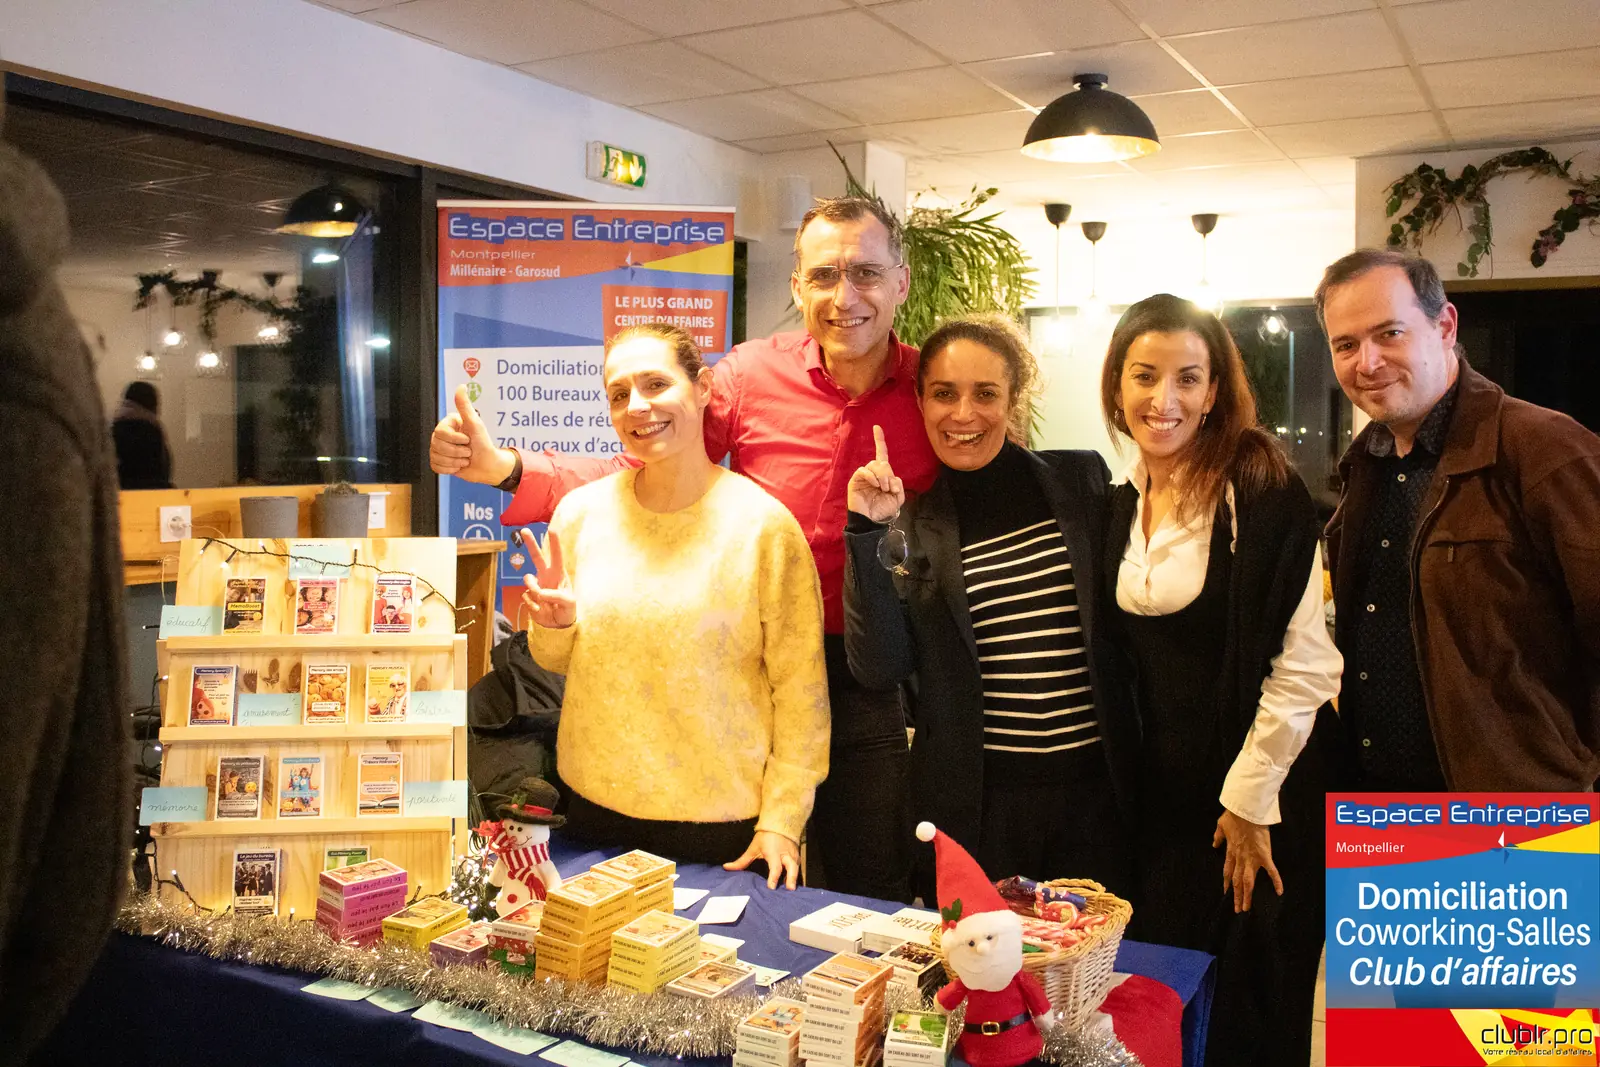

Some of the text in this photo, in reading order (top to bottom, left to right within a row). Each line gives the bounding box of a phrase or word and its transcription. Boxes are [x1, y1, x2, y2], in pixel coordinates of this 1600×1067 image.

[449, 217, 724, 243] Espace Entreprise
[450, 249, 536, 261] Montpellier
[450, 265, 506, 277] Millénaire
[515, 266, 561, 278] Garosud
[615, 296, 713, 310] LE PLUS GRAND
[614, 314, 654, 327] CENTRE
[497, 385, 601, 401] 100 Bureaux
[497, 411, 506, 427] 7
[511, 410, 559, 427] Salles
[563, 410, 584, 427] de
[497, 437, 516, 449] 70
[521, 437, 580, 453] Locaux
[464, 502, 494, 521] Nos
